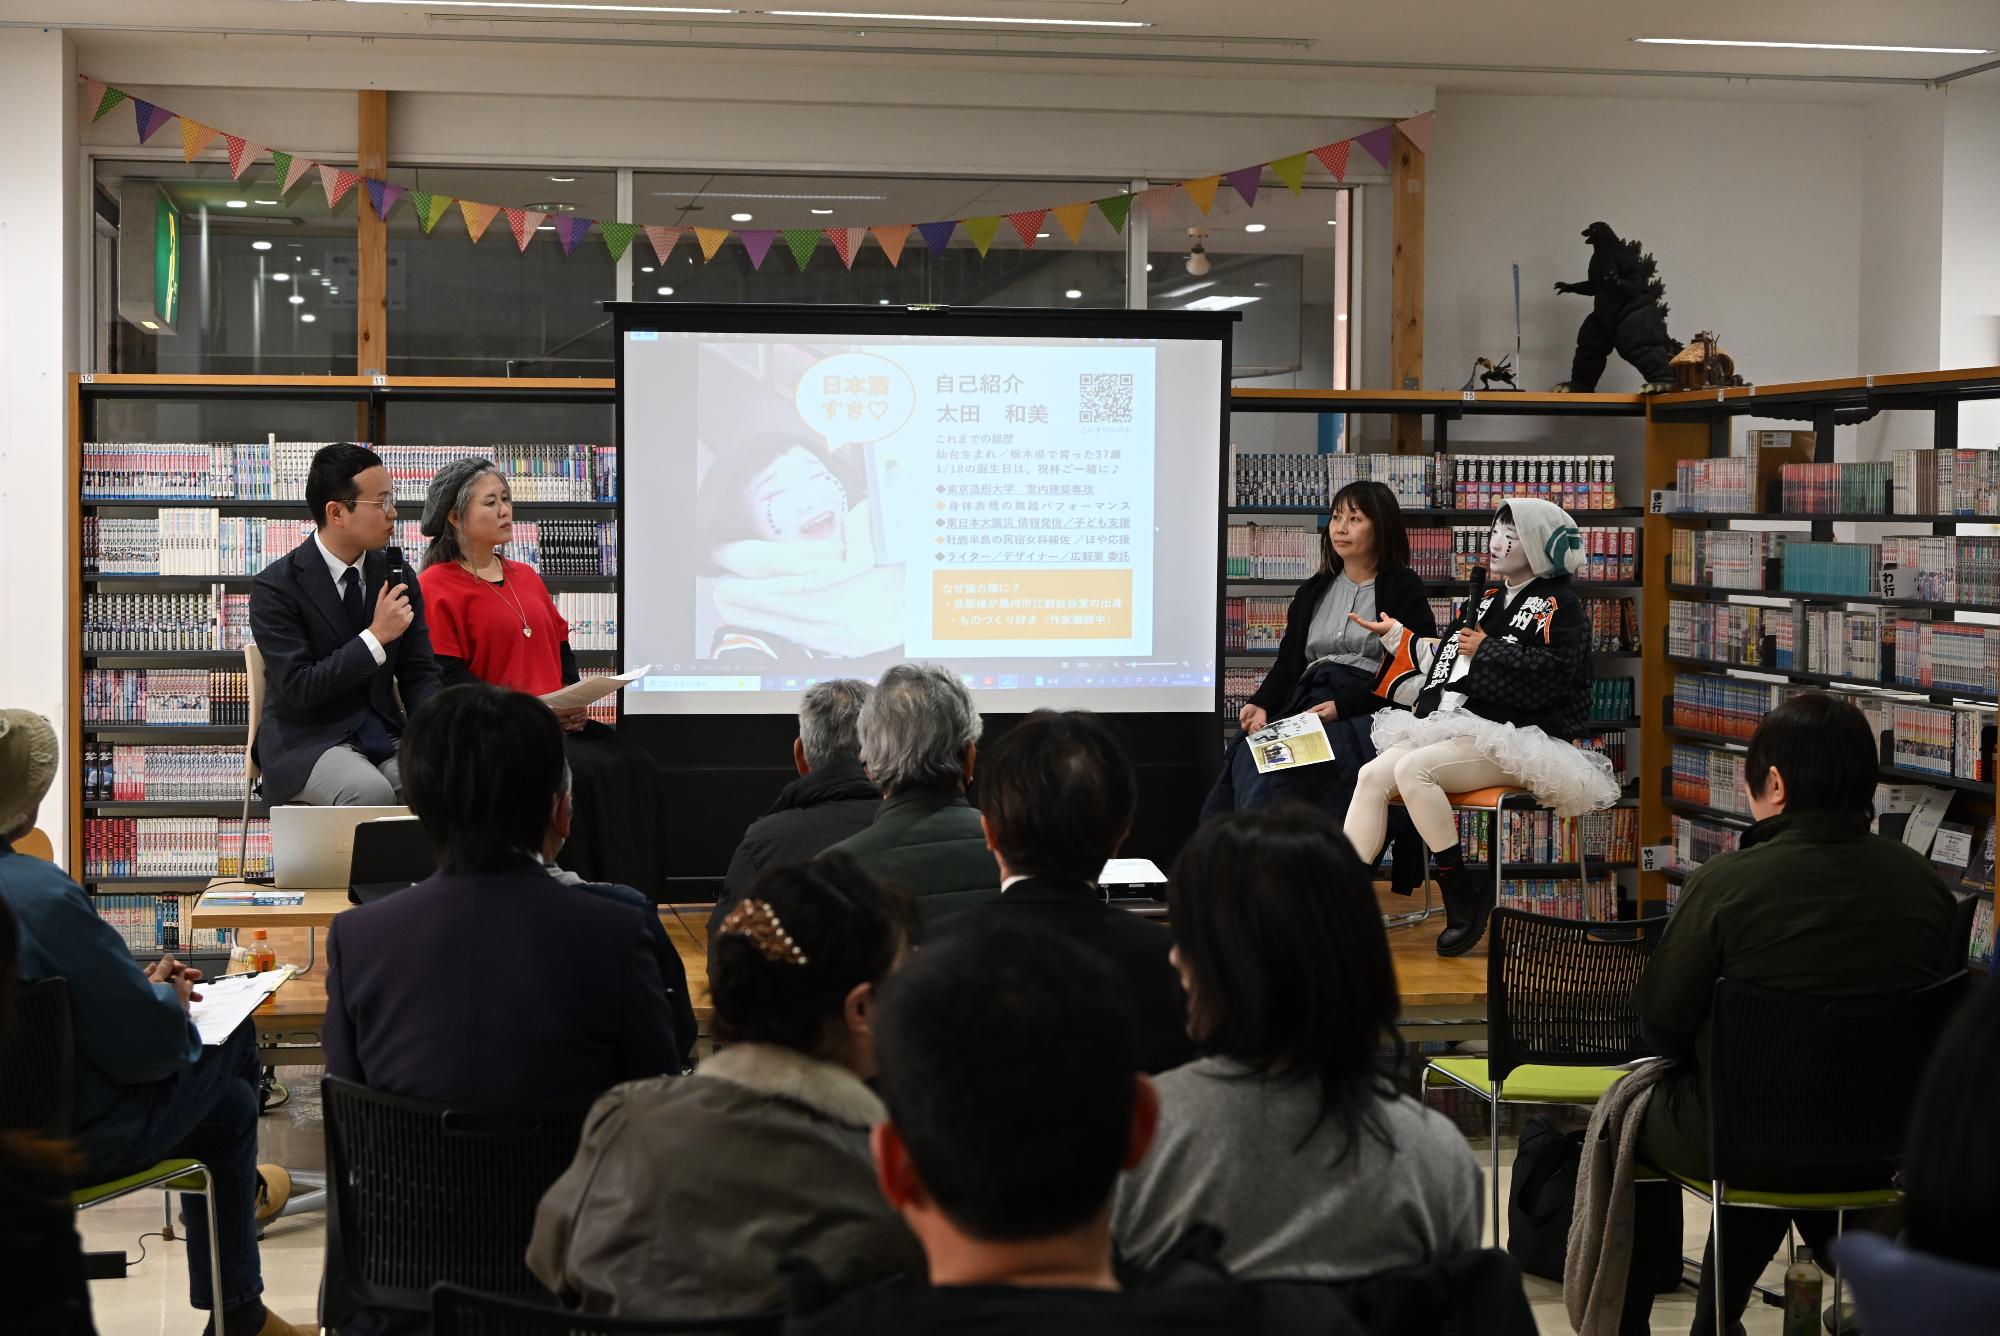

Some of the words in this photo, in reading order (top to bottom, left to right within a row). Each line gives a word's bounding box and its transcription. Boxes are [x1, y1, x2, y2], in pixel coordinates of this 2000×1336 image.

[82, 374, 93, 383] 10
[823, 374, 889, 396] 日本酒
[936, 373, 1024, 394] 自己紹介
[936, 403, 981, 424] 太田
[1004, 403, 1049, 424] 和美
[1652, 491, 1663, 513] ま行
[946, 516, 1014, 529] 東日本大震災
[1882, 572, 1896, 597] わ行
[1643, 848, 1654, 870] や行
